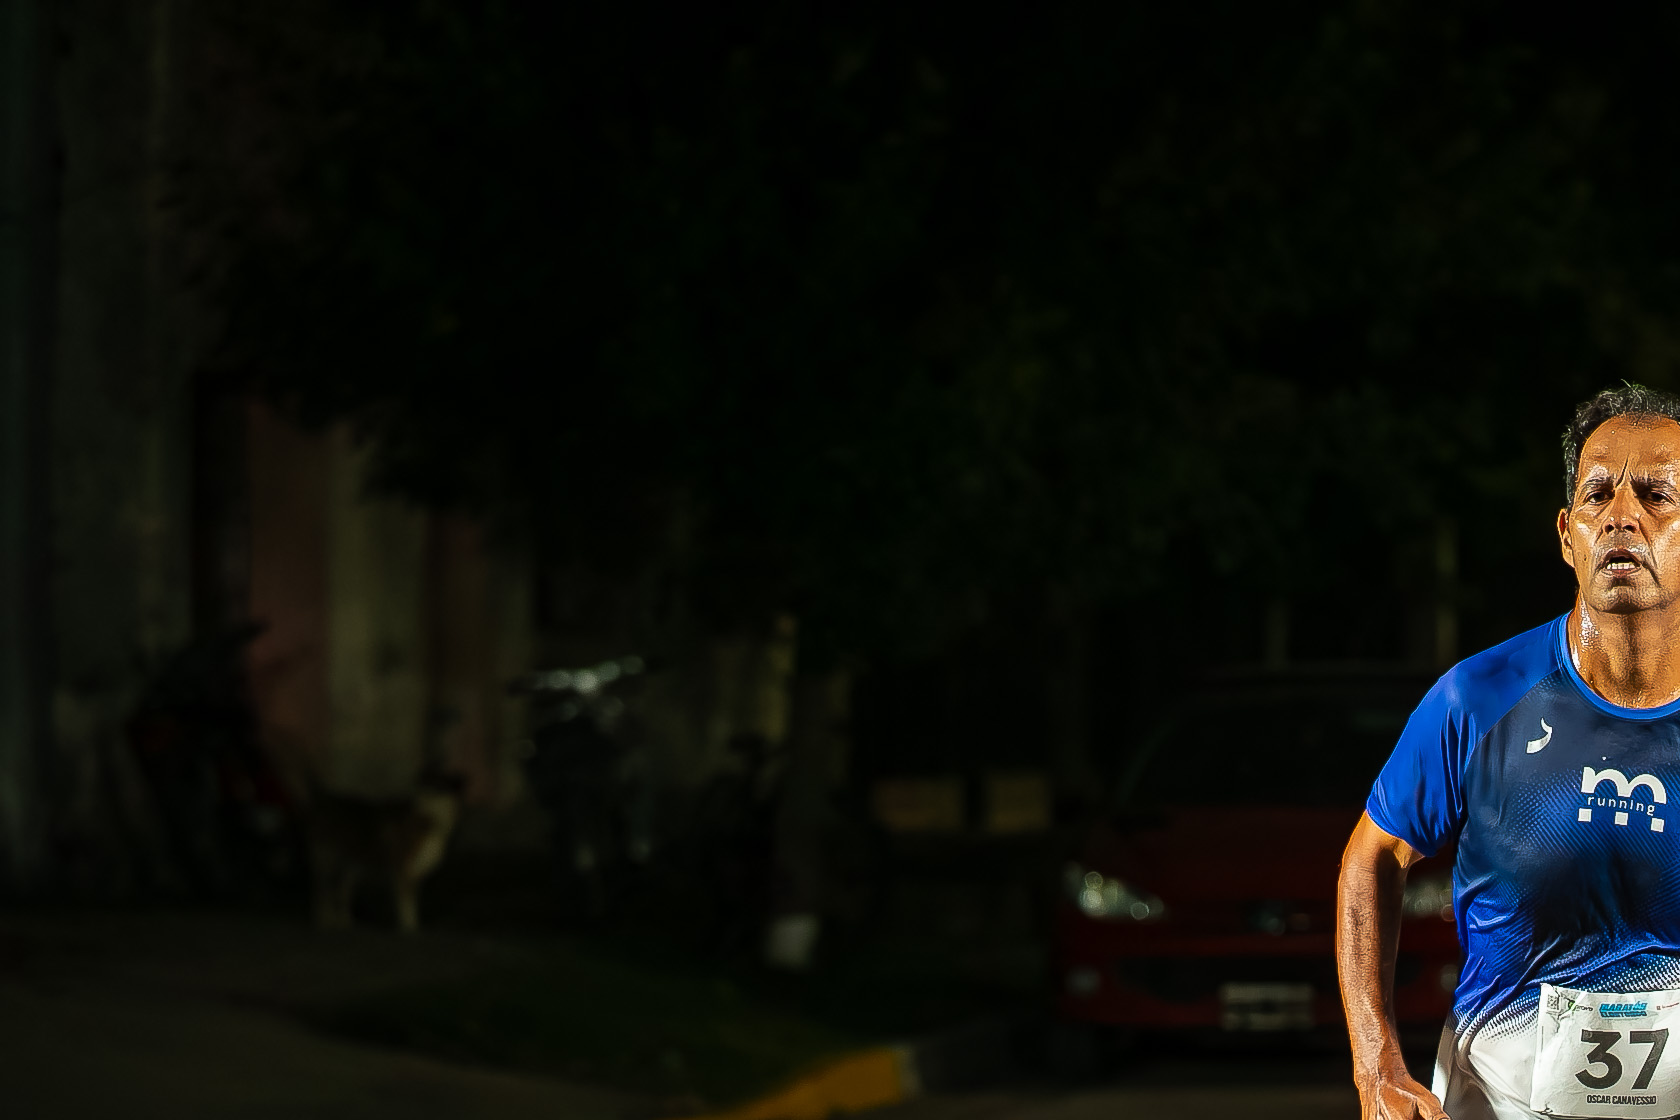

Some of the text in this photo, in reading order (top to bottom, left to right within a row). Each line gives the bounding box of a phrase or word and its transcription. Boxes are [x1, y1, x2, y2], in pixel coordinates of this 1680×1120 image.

[1587, 796, 1656, 816] running
[1574, 1028, 1670, 1090] 37
[1587, 1094, 1611, 1104] OSCAR
